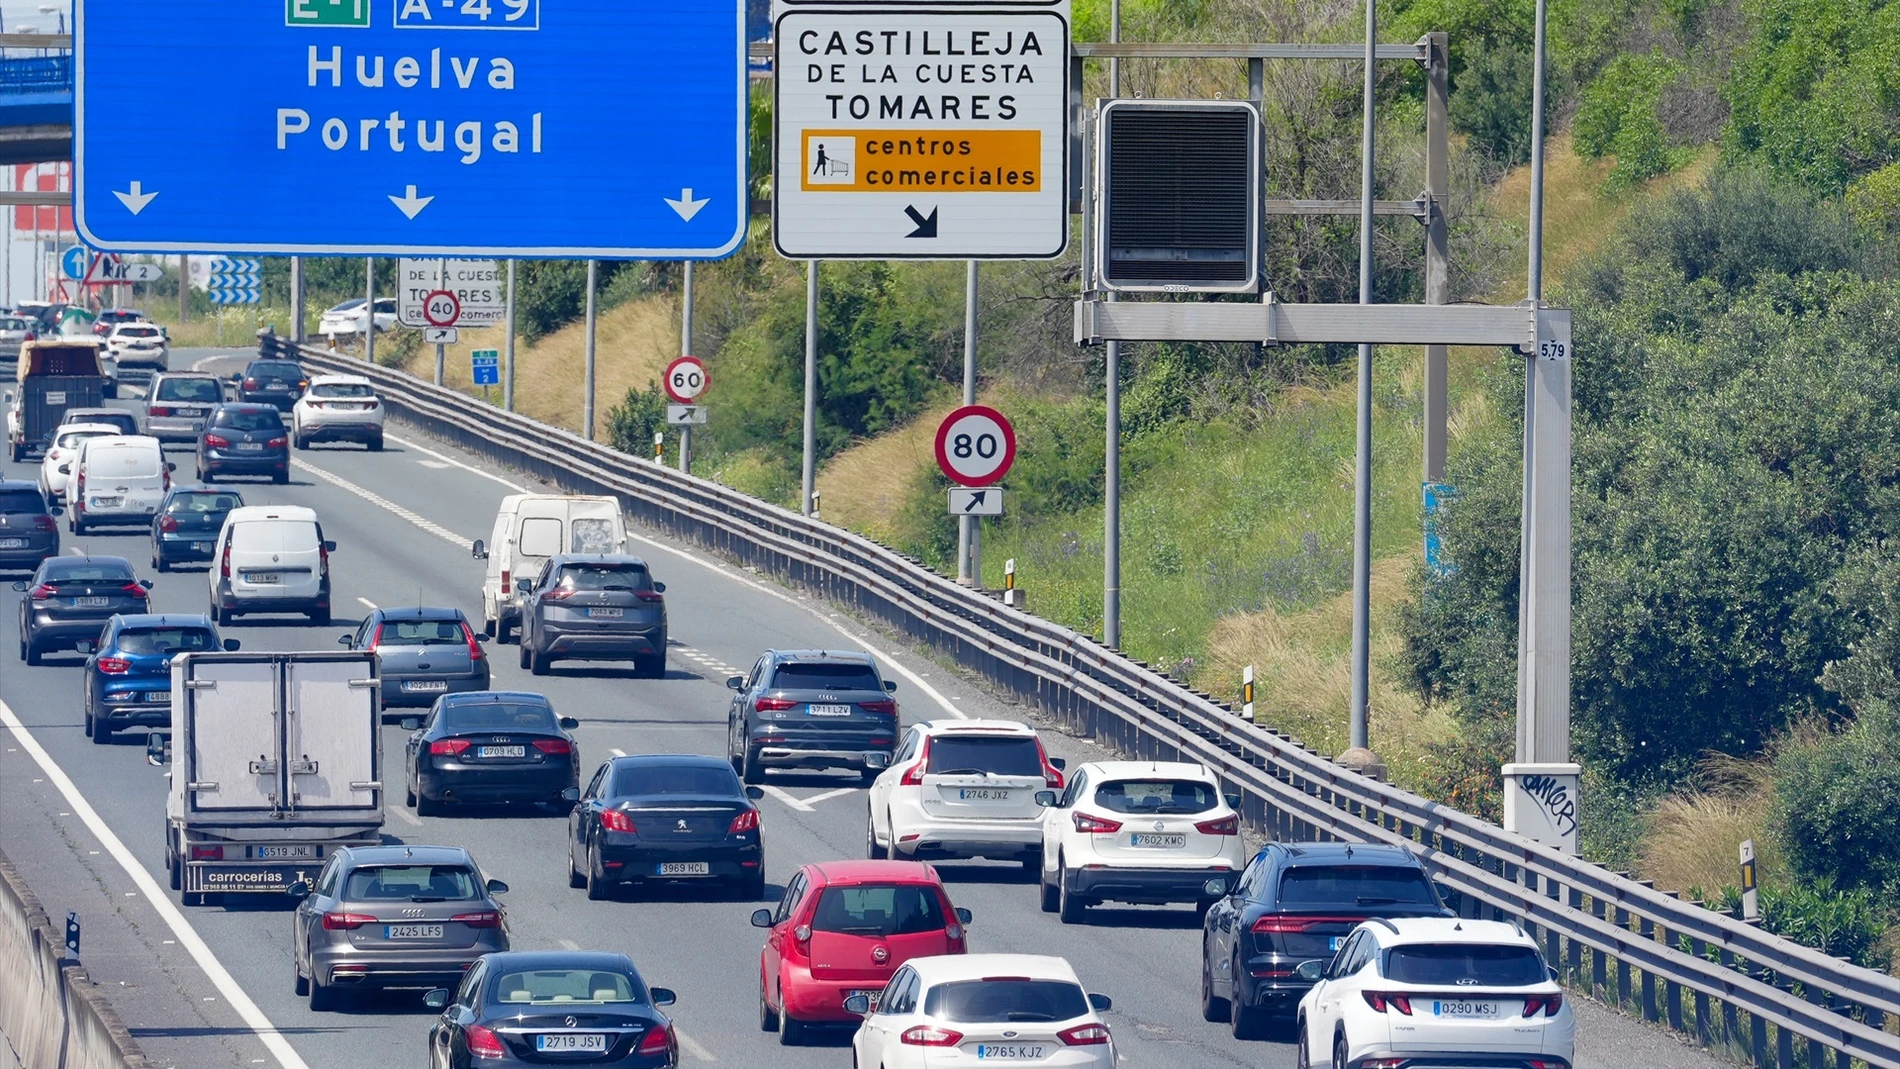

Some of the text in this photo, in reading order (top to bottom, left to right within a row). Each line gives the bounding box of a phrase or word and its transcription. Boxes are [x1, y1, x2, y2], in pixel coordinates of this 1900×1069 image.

[799, 30, 1043, 56] CASTILLEJA
[307, 46, 515, 90] Huelva
[808, 63, 1034, 84] DE LA CUESTA
[826, 94, 1018, 120] TOMARES
[277, 108, 543, 165] Portugal
[866, 137, 971, 156] centros
[866, 165, 1035, 186] comerciales
[140, 266, 147, 278] 2
[409, 270, 426, 280] DE
[409, 289, 492, 302] TORES
[430, 302, 453, 315] 40
[1541, 343, 1565, 357] 5,79
[673, 371, 702, 388] 60
[954, 433, 997, 459] 80
[811, 705, 849, 715] 3711 LZV
[966, 790, 1008, 800] 2746 JXZ
[1138, 835, 1163, 845] 7602
[291, 846, 310, 857] JNL
[1743, 847, 1750, 857] 7
[662, 863, 706, 873] 3969 HCL
[208, 870, 283, 883] carrocerías
[69, 911, 76, 922] 7
[392, 926, 442, 937] 2425 LFS
[1442, 1003, 1497, 1015] 0290 MSJ
[546, 1035, 602, 1048] 2719 JSV
[985, 1045, 1043, 1058] 2765 KJZ
